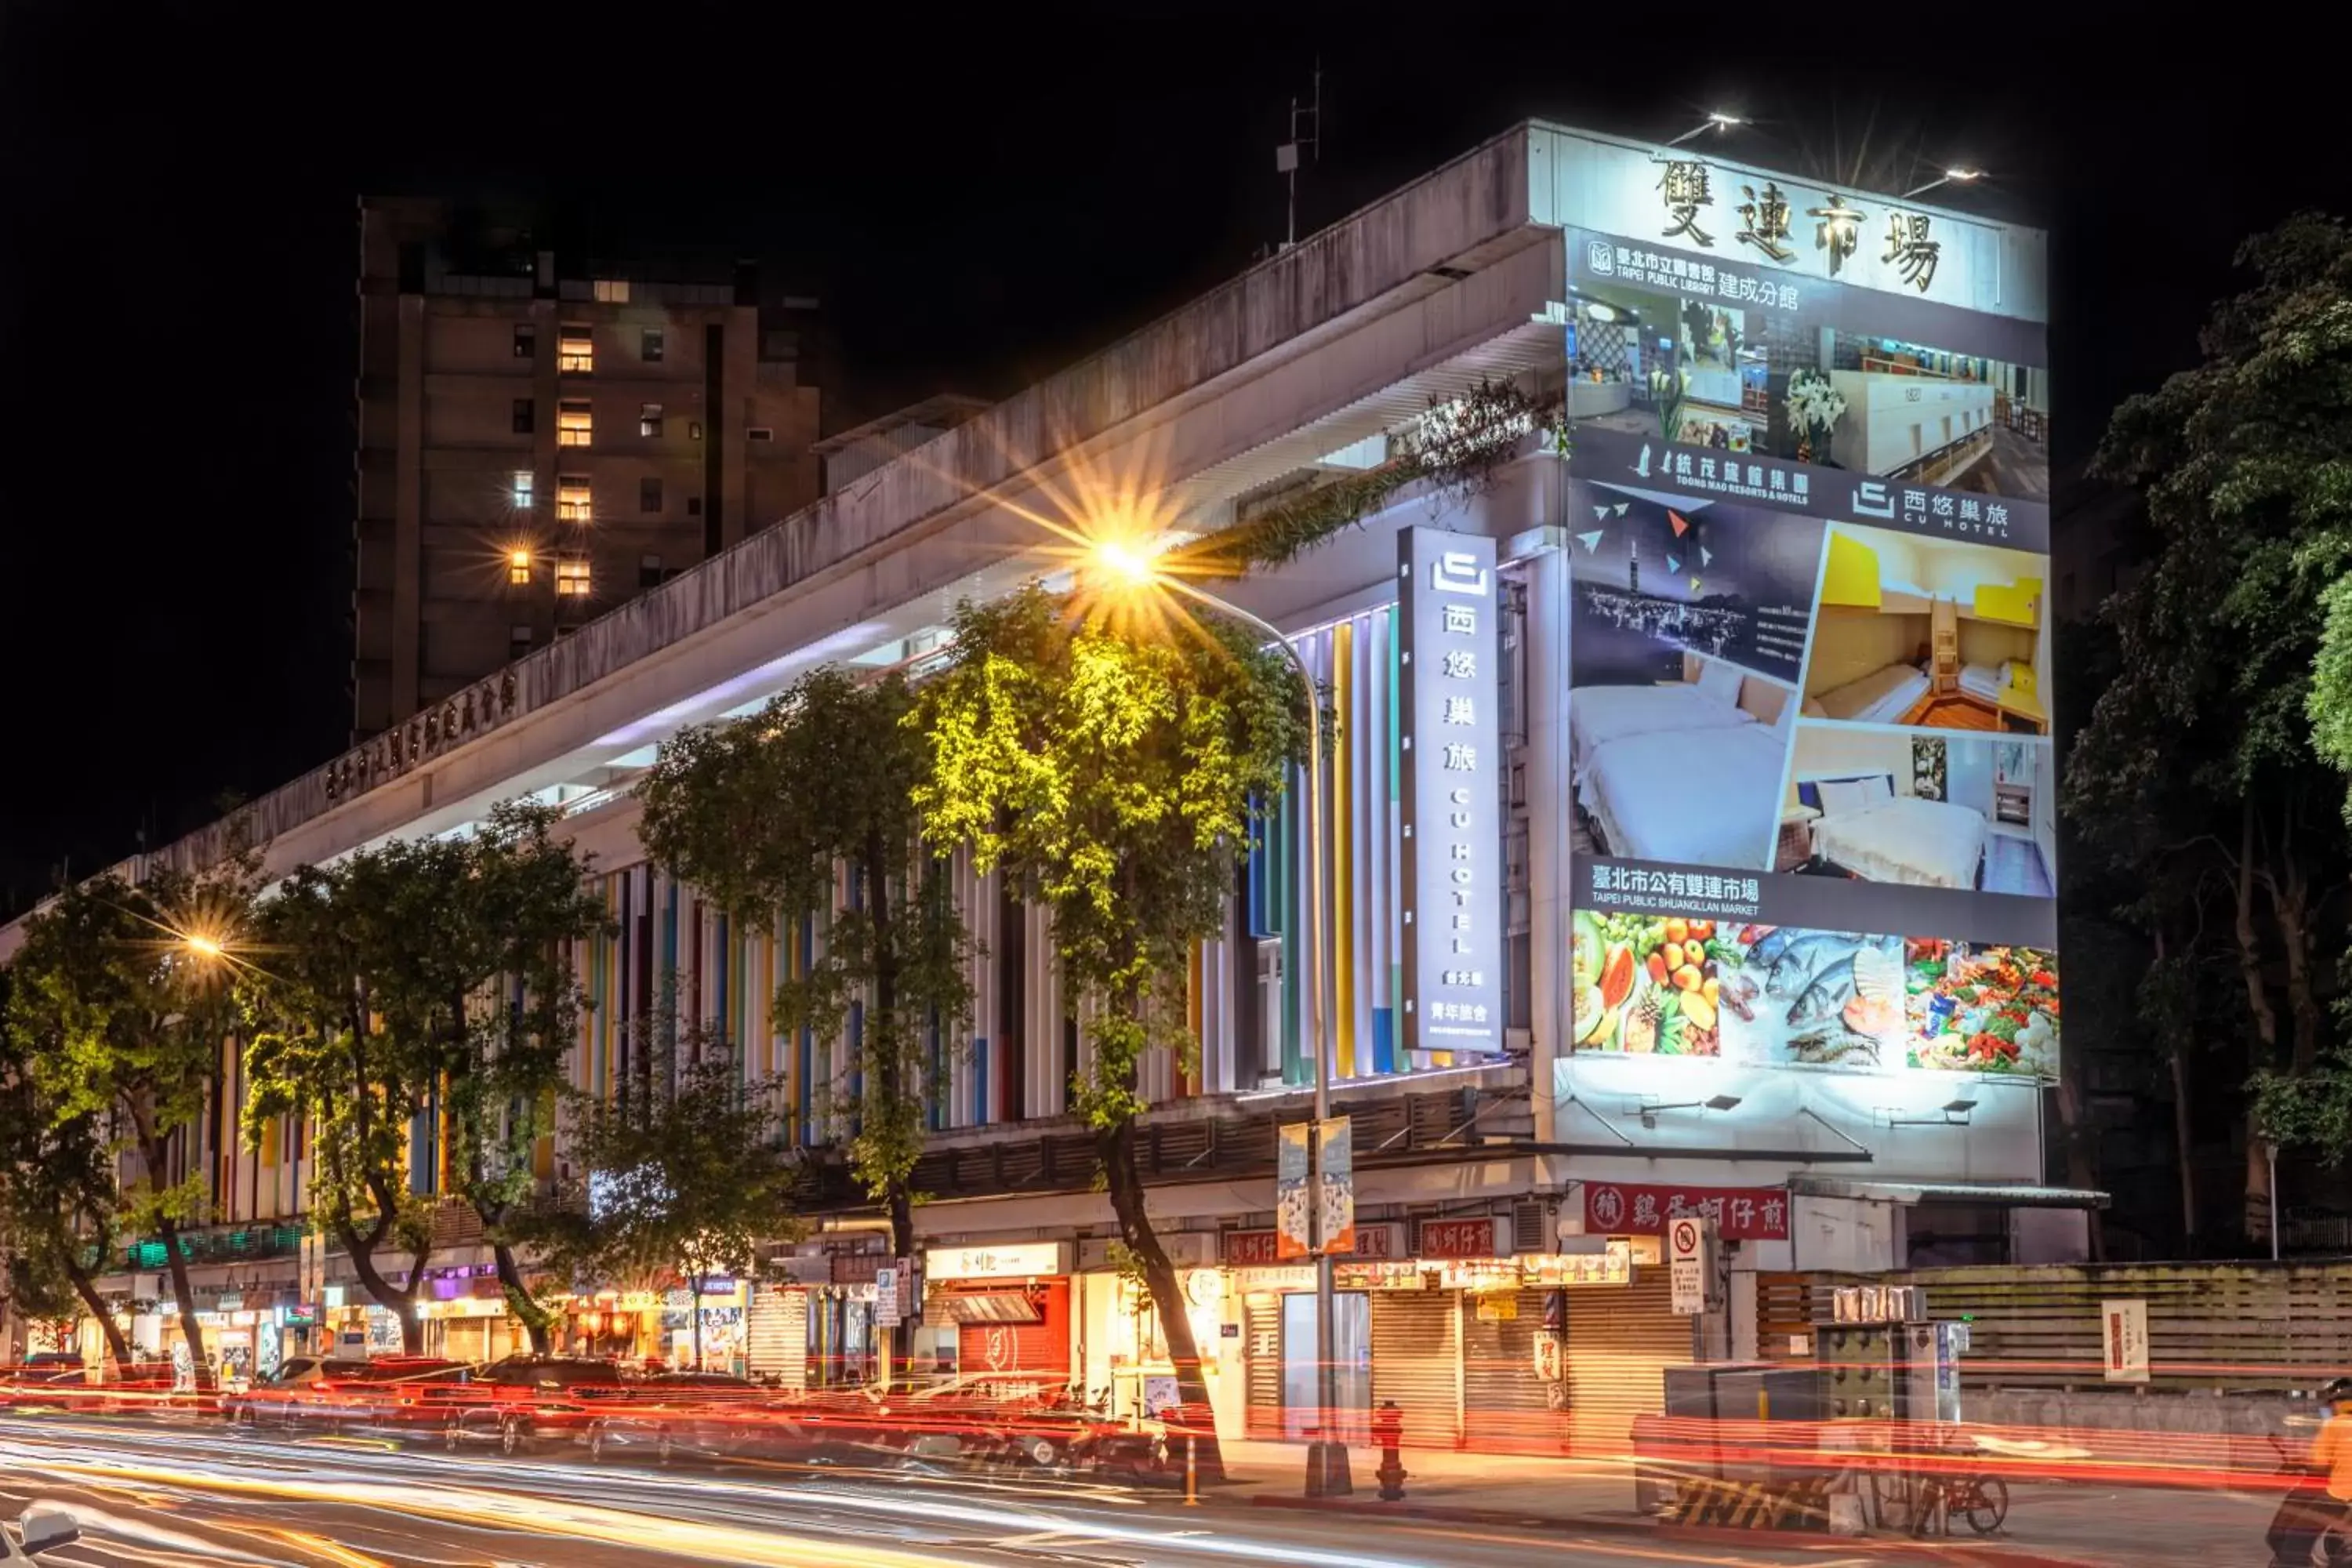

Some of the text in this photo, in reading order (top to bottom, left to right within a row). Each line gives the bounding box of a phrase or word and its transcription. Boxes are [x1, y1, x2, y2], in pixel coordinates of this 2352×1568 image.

[1656, 160, 1941, 293] 雙連市場
[1617, 265, 1715, 296] TAIPEI PUBLIC LIBRARY
[1719, 272, 1798, 310] 建成分館
[1904, 490, 2008, 526] 西悠巢旅
[1904, 513, 2008, 538] CU HOTEL
[1444, 604, 1476, 771] 西悠巢旅
[1452, 844, 1473, 954] HOTEL
[1592, 865, 1759, 902] 臺北市公有雙連市場
[1592, 891, 1620, 904] TAIPEI
[1622, 895, 1657, 907] PUBLIC
[1721, 903, 1759, 916] MARKET
